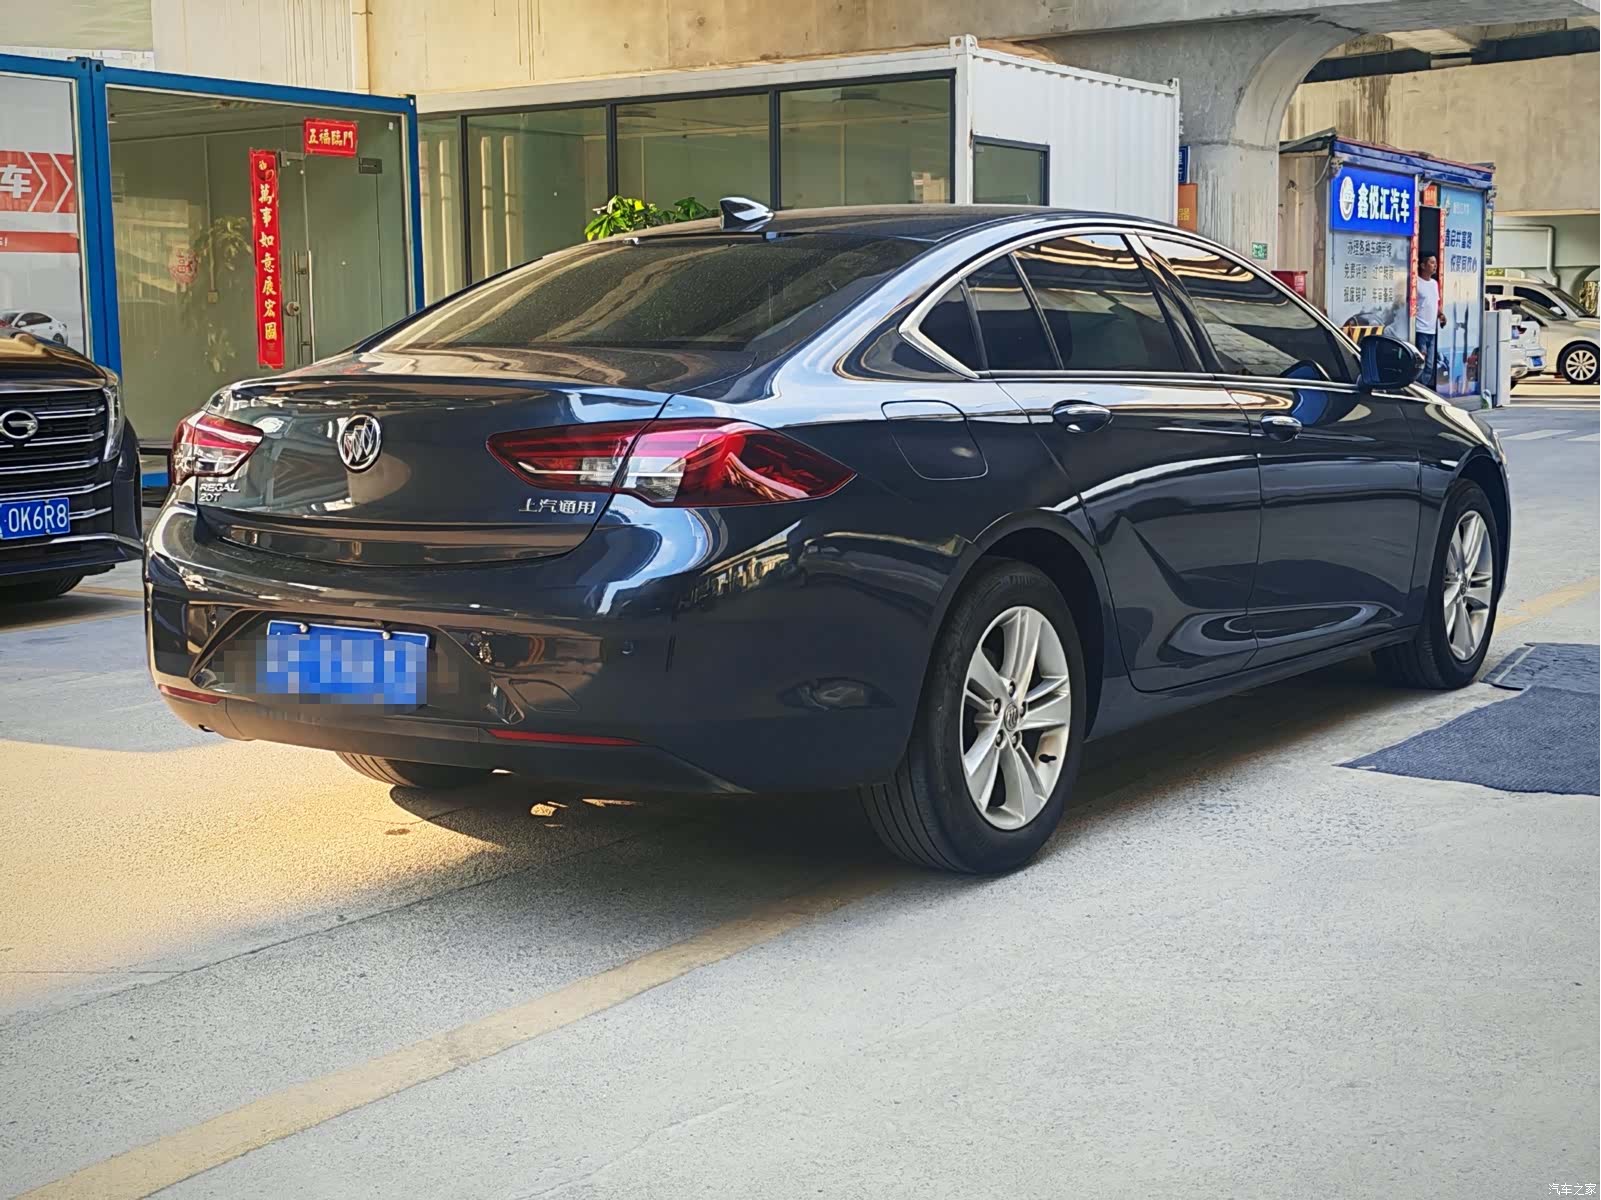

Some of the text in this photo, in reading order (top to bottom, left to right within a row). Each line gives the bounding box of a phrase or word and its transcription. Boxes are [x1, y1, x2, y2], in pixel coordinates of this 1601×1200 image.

[308, 128, 354, 148] 五福臨門
[1357, 182, 1410, 223] 鑫悦汇汽车
[199, 482, 240, 492] REGAL
[199, 492, 221, 502] 20T
[518, 498, 597, 514] 上汽通用
